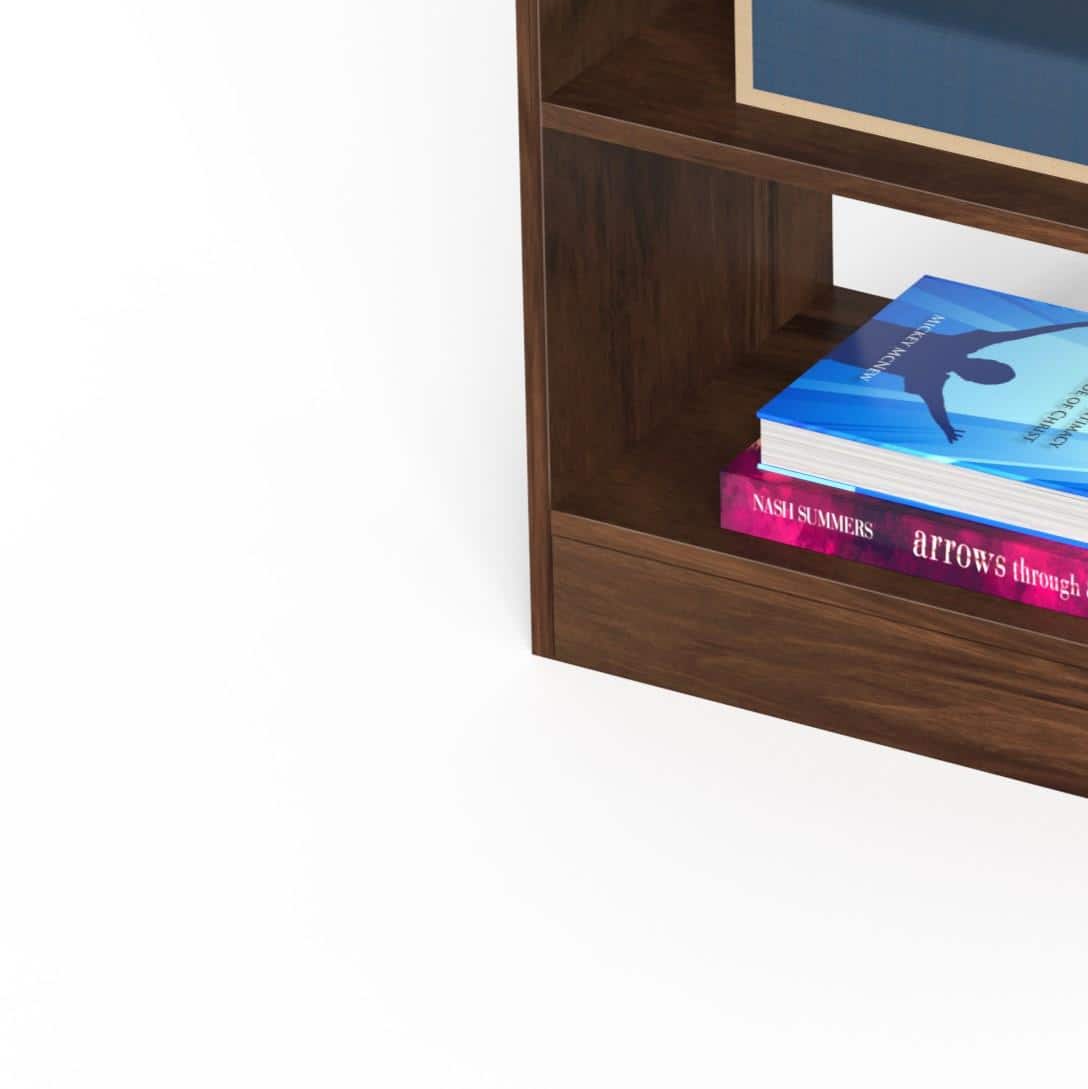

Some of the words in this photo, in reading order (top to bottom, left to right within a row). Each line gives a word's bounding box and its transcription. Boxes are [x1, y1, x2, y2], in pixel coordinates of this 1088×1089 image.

[900, 314, 944, 348] MICKEY
[1062, 396, 1081, 410] OF
[1023, 410, 1067, 443] CHRIST
[752, 493, 794, 520] NASH
[797, 505, 875, 540] SUMMERS
[912, 529, 1006, 578] arrows
[1012, 557, 1081, 600] through
